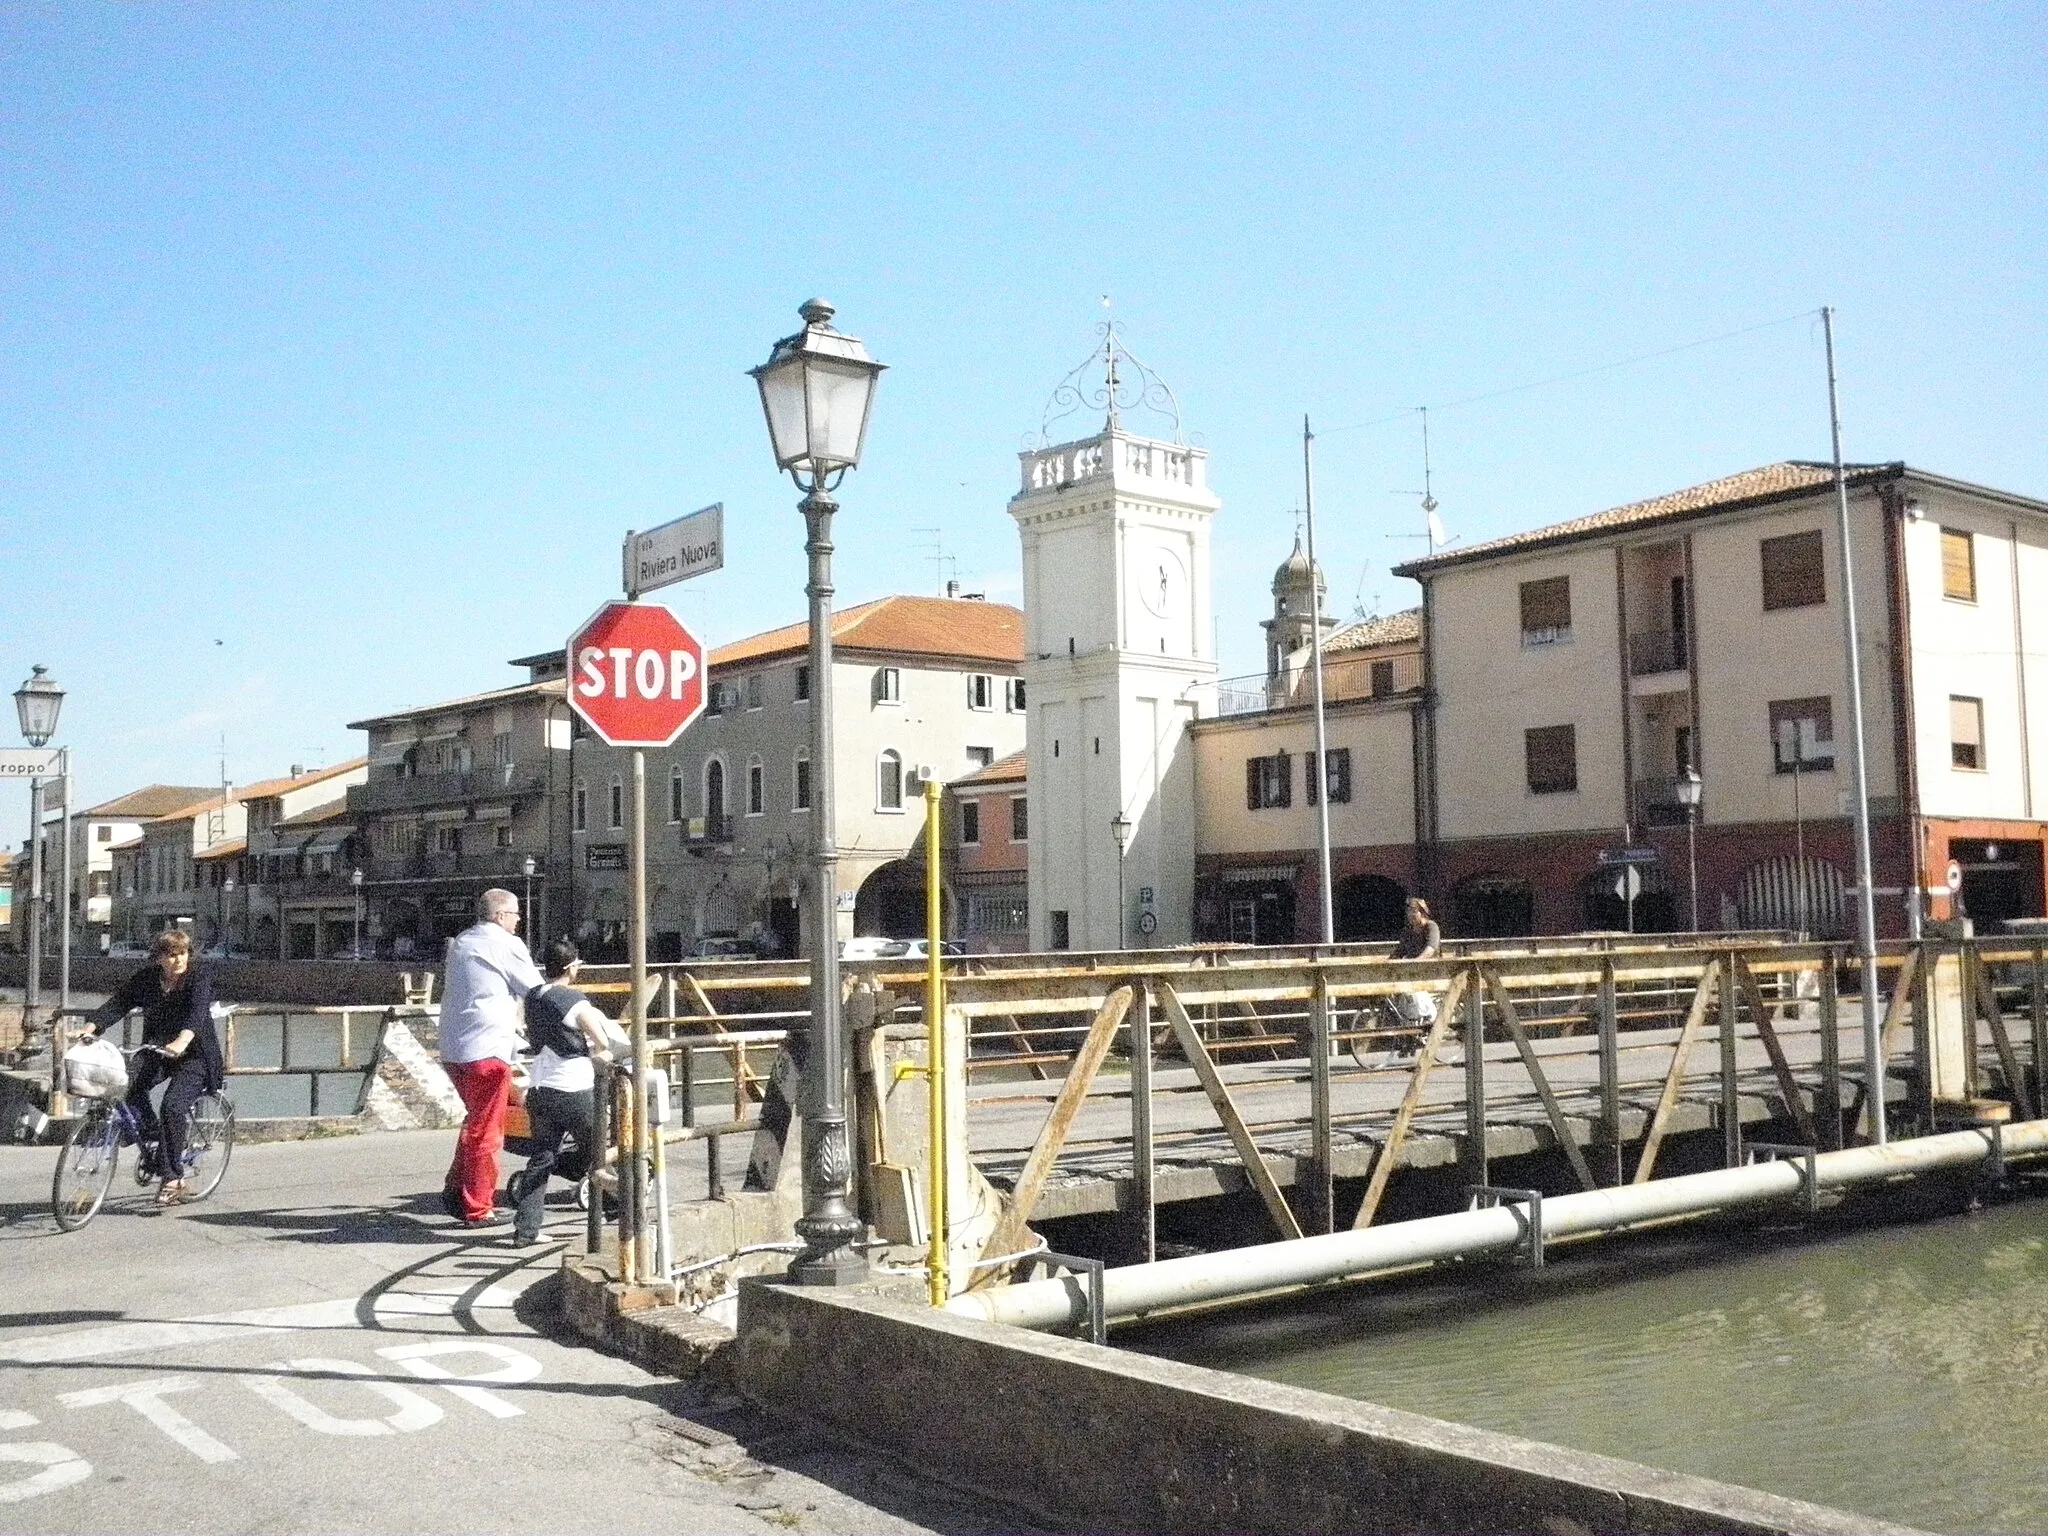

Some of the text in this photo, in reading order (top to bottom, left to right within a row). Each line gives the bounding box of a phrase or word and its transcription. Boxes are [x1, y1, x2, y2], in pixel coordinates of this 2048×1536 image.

[640, 541, 717, 581] Riviera Nuova
[578, 646, 697, 700] STOP
[1, 764, 45, 774] roppo
